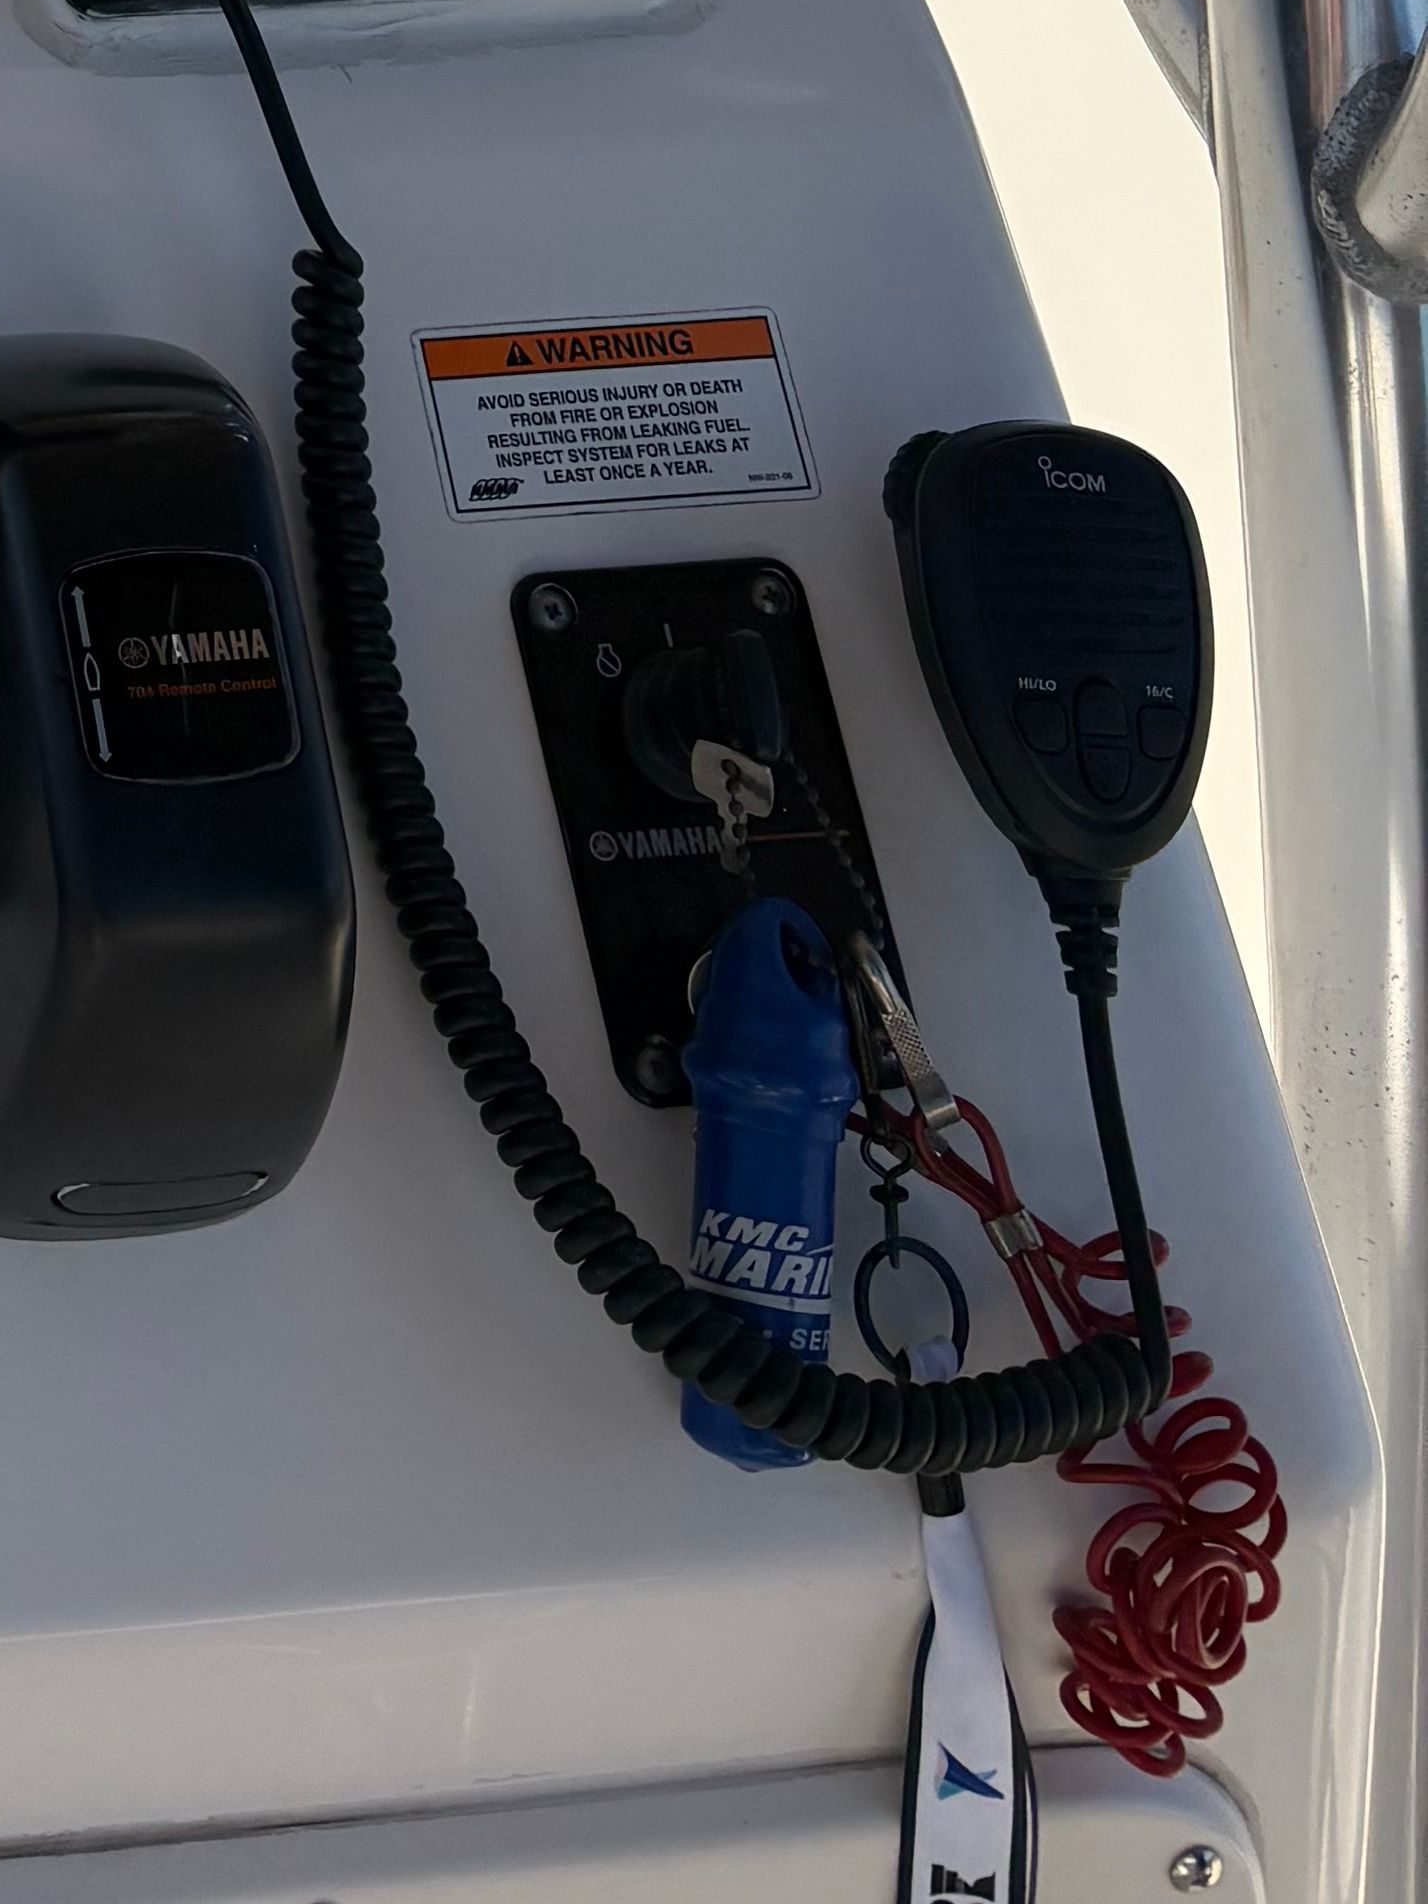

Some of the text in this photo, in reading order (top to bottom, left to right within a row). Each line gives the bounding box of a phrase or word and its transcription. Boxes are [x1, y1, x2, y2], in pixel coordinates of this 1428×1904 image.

[536, 329, 694, 364] WARNING
[477, 379, 743, 410] AVOID SERIOUS INJURY OR DEATH
[510, 400, 719, 427] FROM FIRE OR EXPLOSION
[488, 418, 750, 449] RESULTING FROM LEAKING FUEL.
[496, 437, 750, 468] INSPECT SYSTEM FOR LEAKS AT
[544, 460, 713, 484] LEAST ONCE A YEAR.
[151, 628, 270, 666] YAMAHA
[158, 682, 217, 698] Remote
[220, 677, 278, 693] Control
[1018, 675, 1058, 692] HI/LO
[616, 824, 723, 860] YAMAHA
[699, 1208, 810, 1252] KMC
